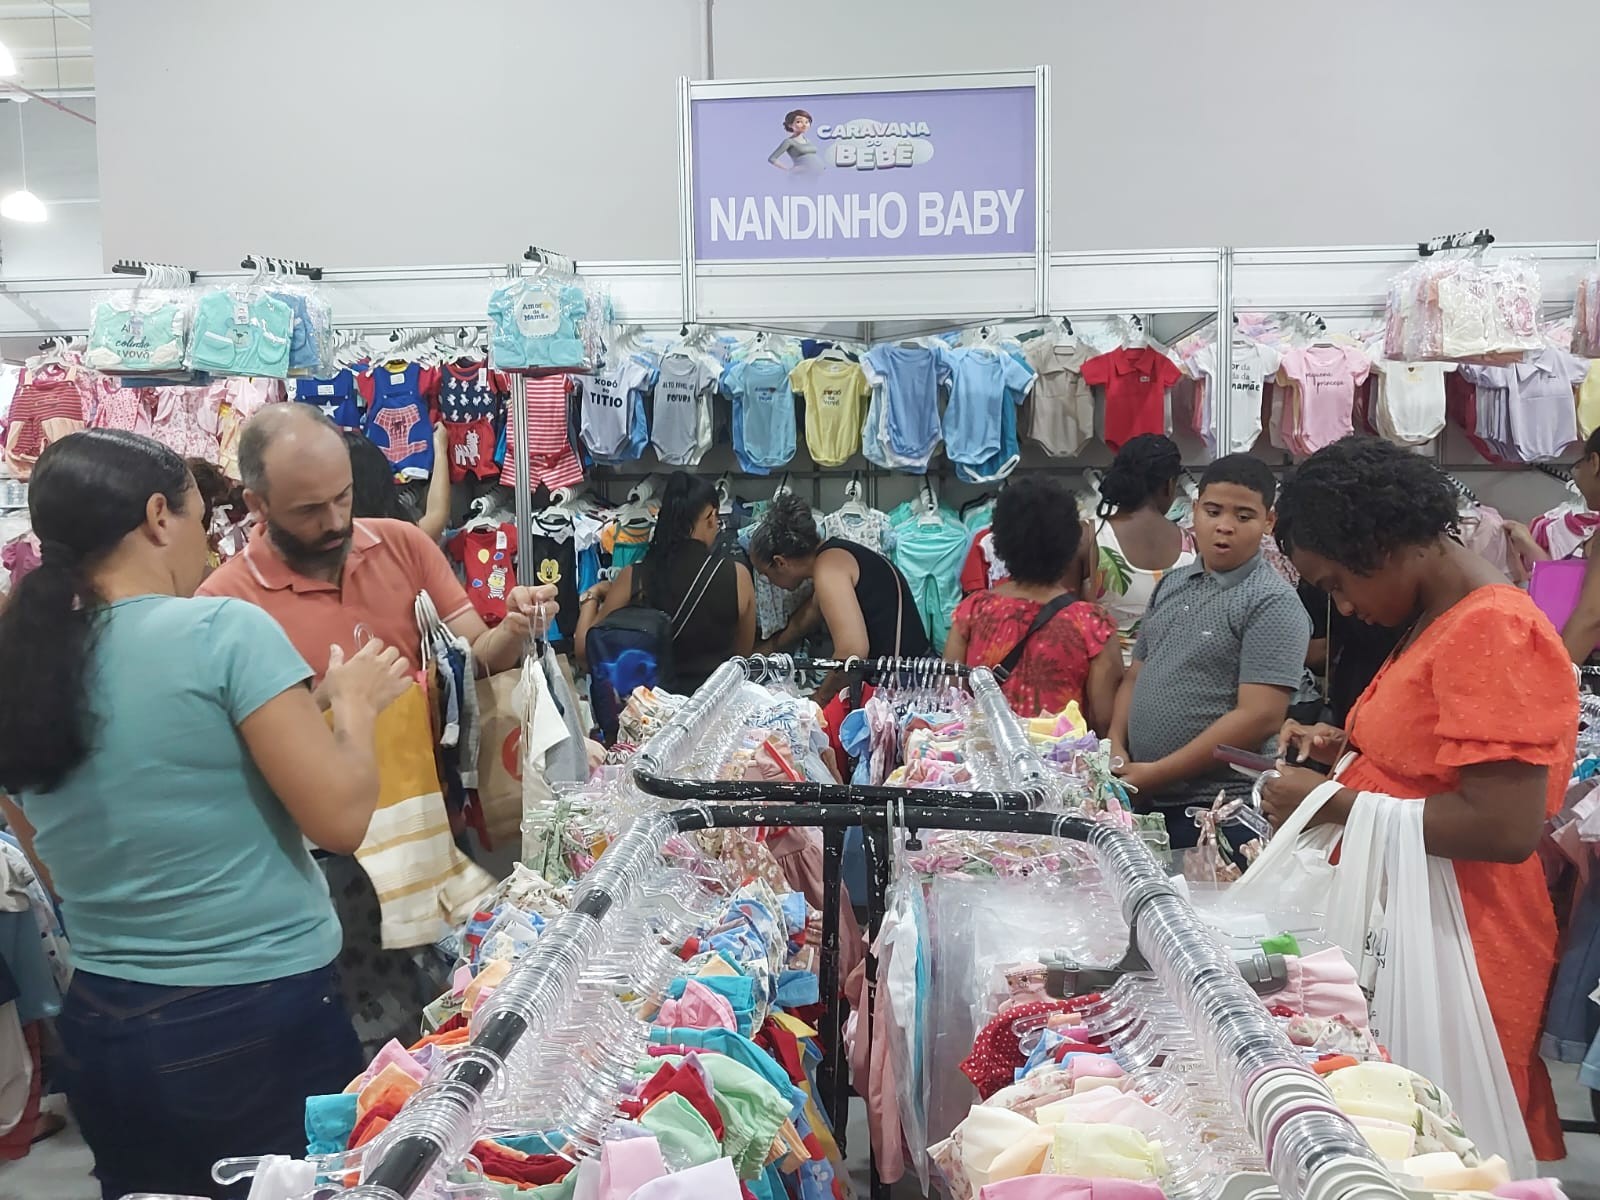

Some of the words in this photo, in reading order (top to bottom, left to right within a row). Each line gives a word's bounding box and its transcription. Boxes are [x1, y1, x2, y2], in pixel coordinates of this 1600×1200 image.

[816, 121, 933, 140] CARAVANA
[835, 139, 914, 171] BEBÊ
[709, 191, 908, 242] NANDINHO
[917, 188, 1025, 237] BABY
[590, 391, 623, 408] TITIO
